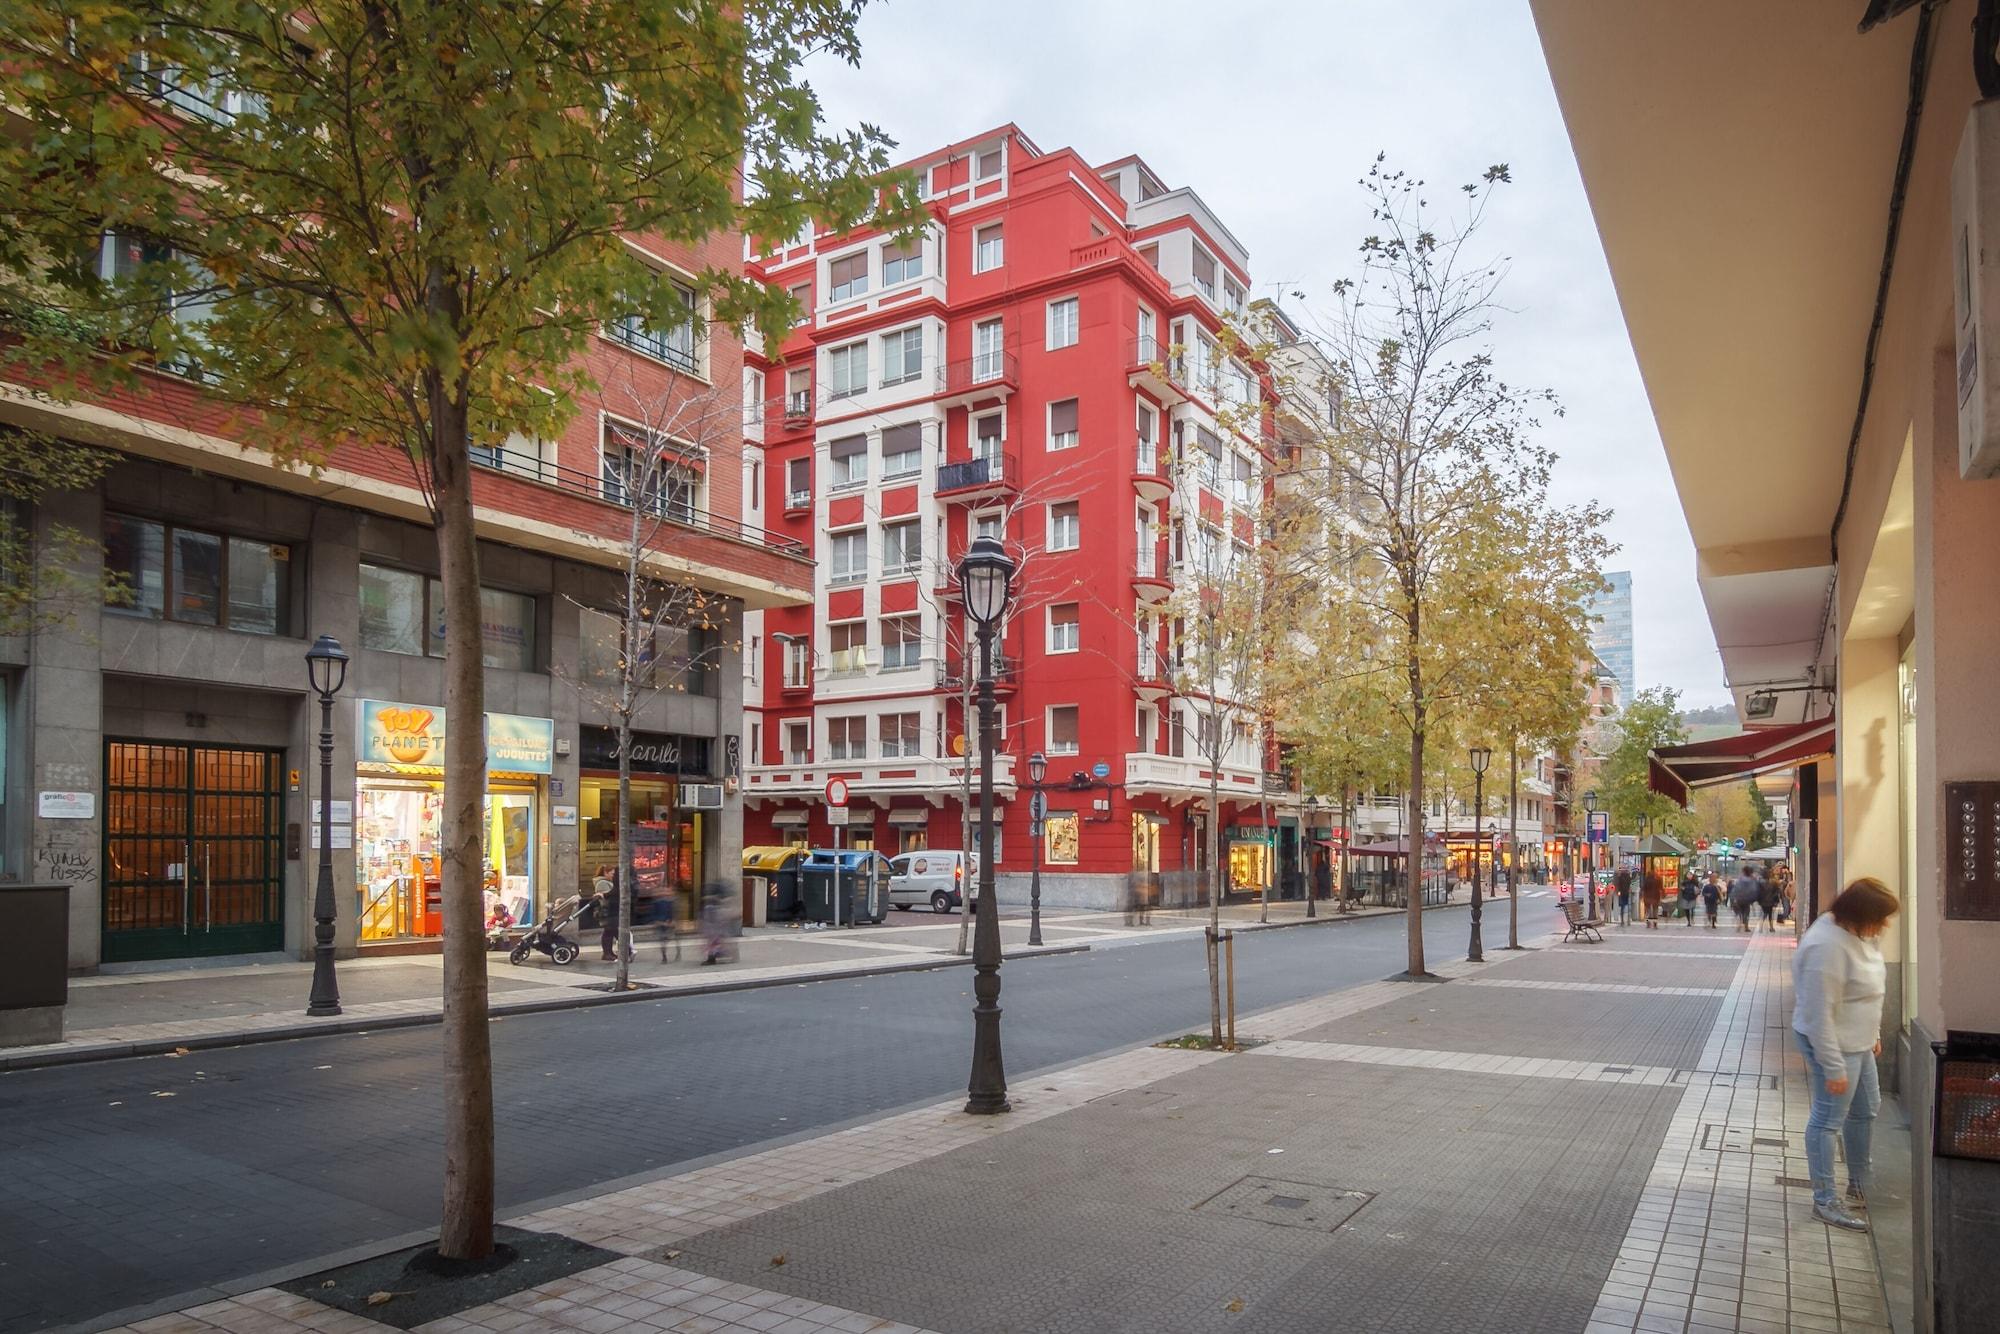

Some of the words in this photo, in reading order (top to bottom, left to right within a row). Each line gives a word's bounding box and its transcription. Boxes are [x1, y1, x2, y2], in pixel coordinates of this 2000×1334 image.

[377, 706, 435, 733] TOY
[372, 735, 445, 751] PLANET
[496, 749, 548, 762] JUGUETES
